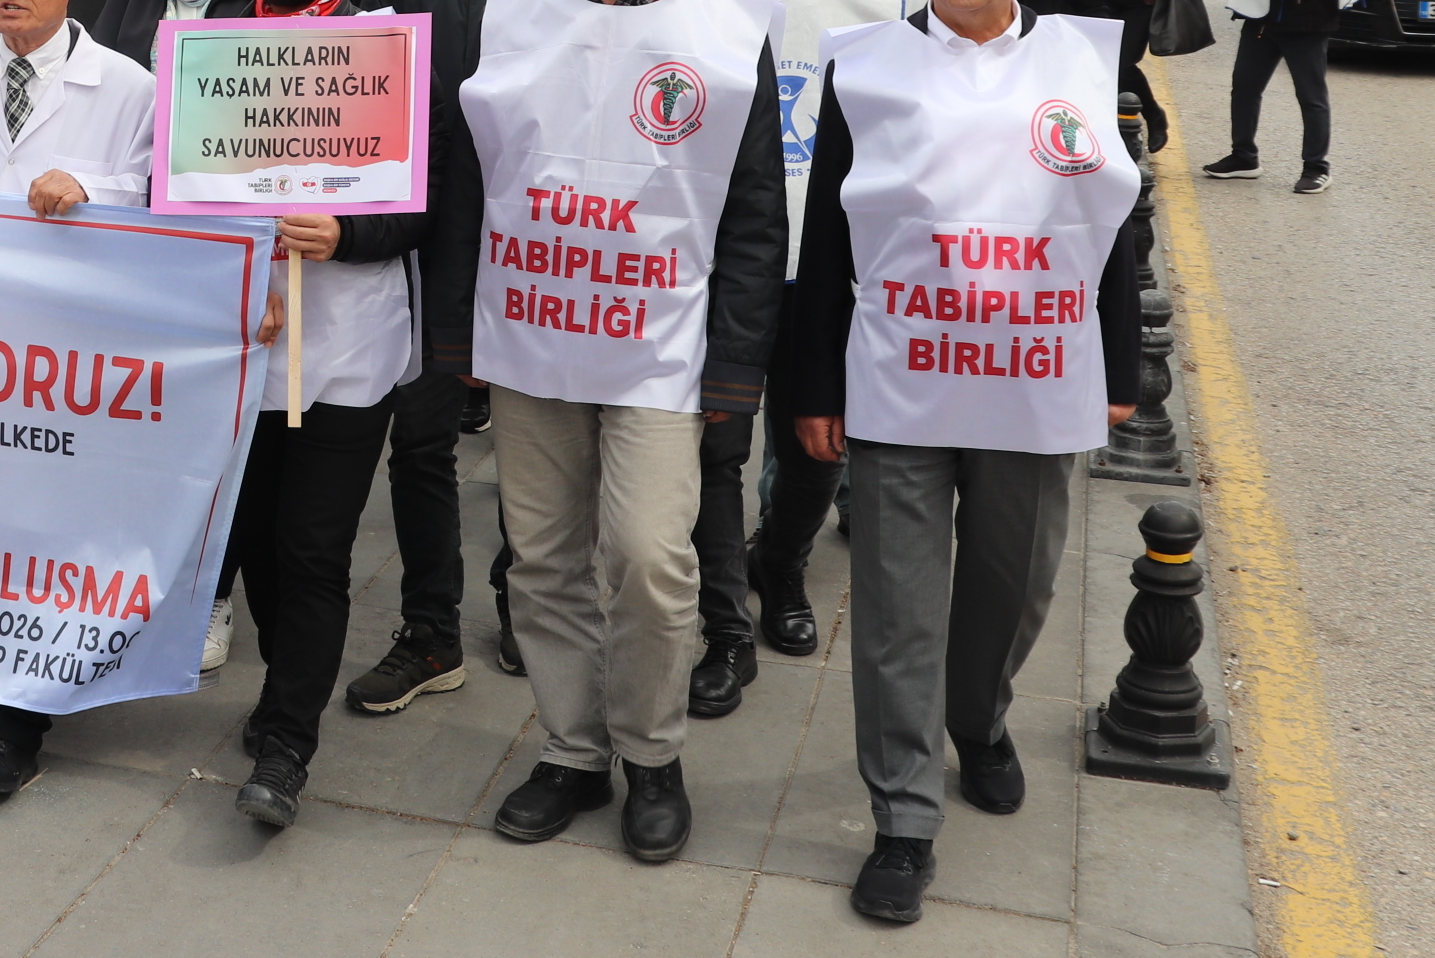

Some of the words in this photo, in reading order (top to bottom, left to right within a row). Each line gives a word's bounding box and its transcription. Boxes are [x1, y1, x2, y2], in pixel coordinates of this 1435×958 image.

[237, 45, 351, 67] HALKLARIN
[197, 77, 271, 99] YAŞAM
[280, 76, 306, 97] VE
[314, 73, 390, 97] SAĞLIK
[244, 107, 341, 128] HAKKININ
[635, 115, 648, 132] TÜRK
[648, 130, 678, 141] TABİPLERİ
[201, 136, 381, 158] SAVUNUCUSUYUZ
[1036, 149, 1051, 165] TÜRK
[785, 168, 803, 177] SES
[526, 184, 639, 234] TÜRK
[489, 231, 678, 289] TABİPLERİ
[932, 228, 1052, 271] TÜRK
[504, 284, 647, 340] BİRLİĞİ
[883, 280, 1085, 325] TABİPLERİ
[908, 332, 1064, 379] BİRLİĞİ
[51, 621, 69, 646] /
